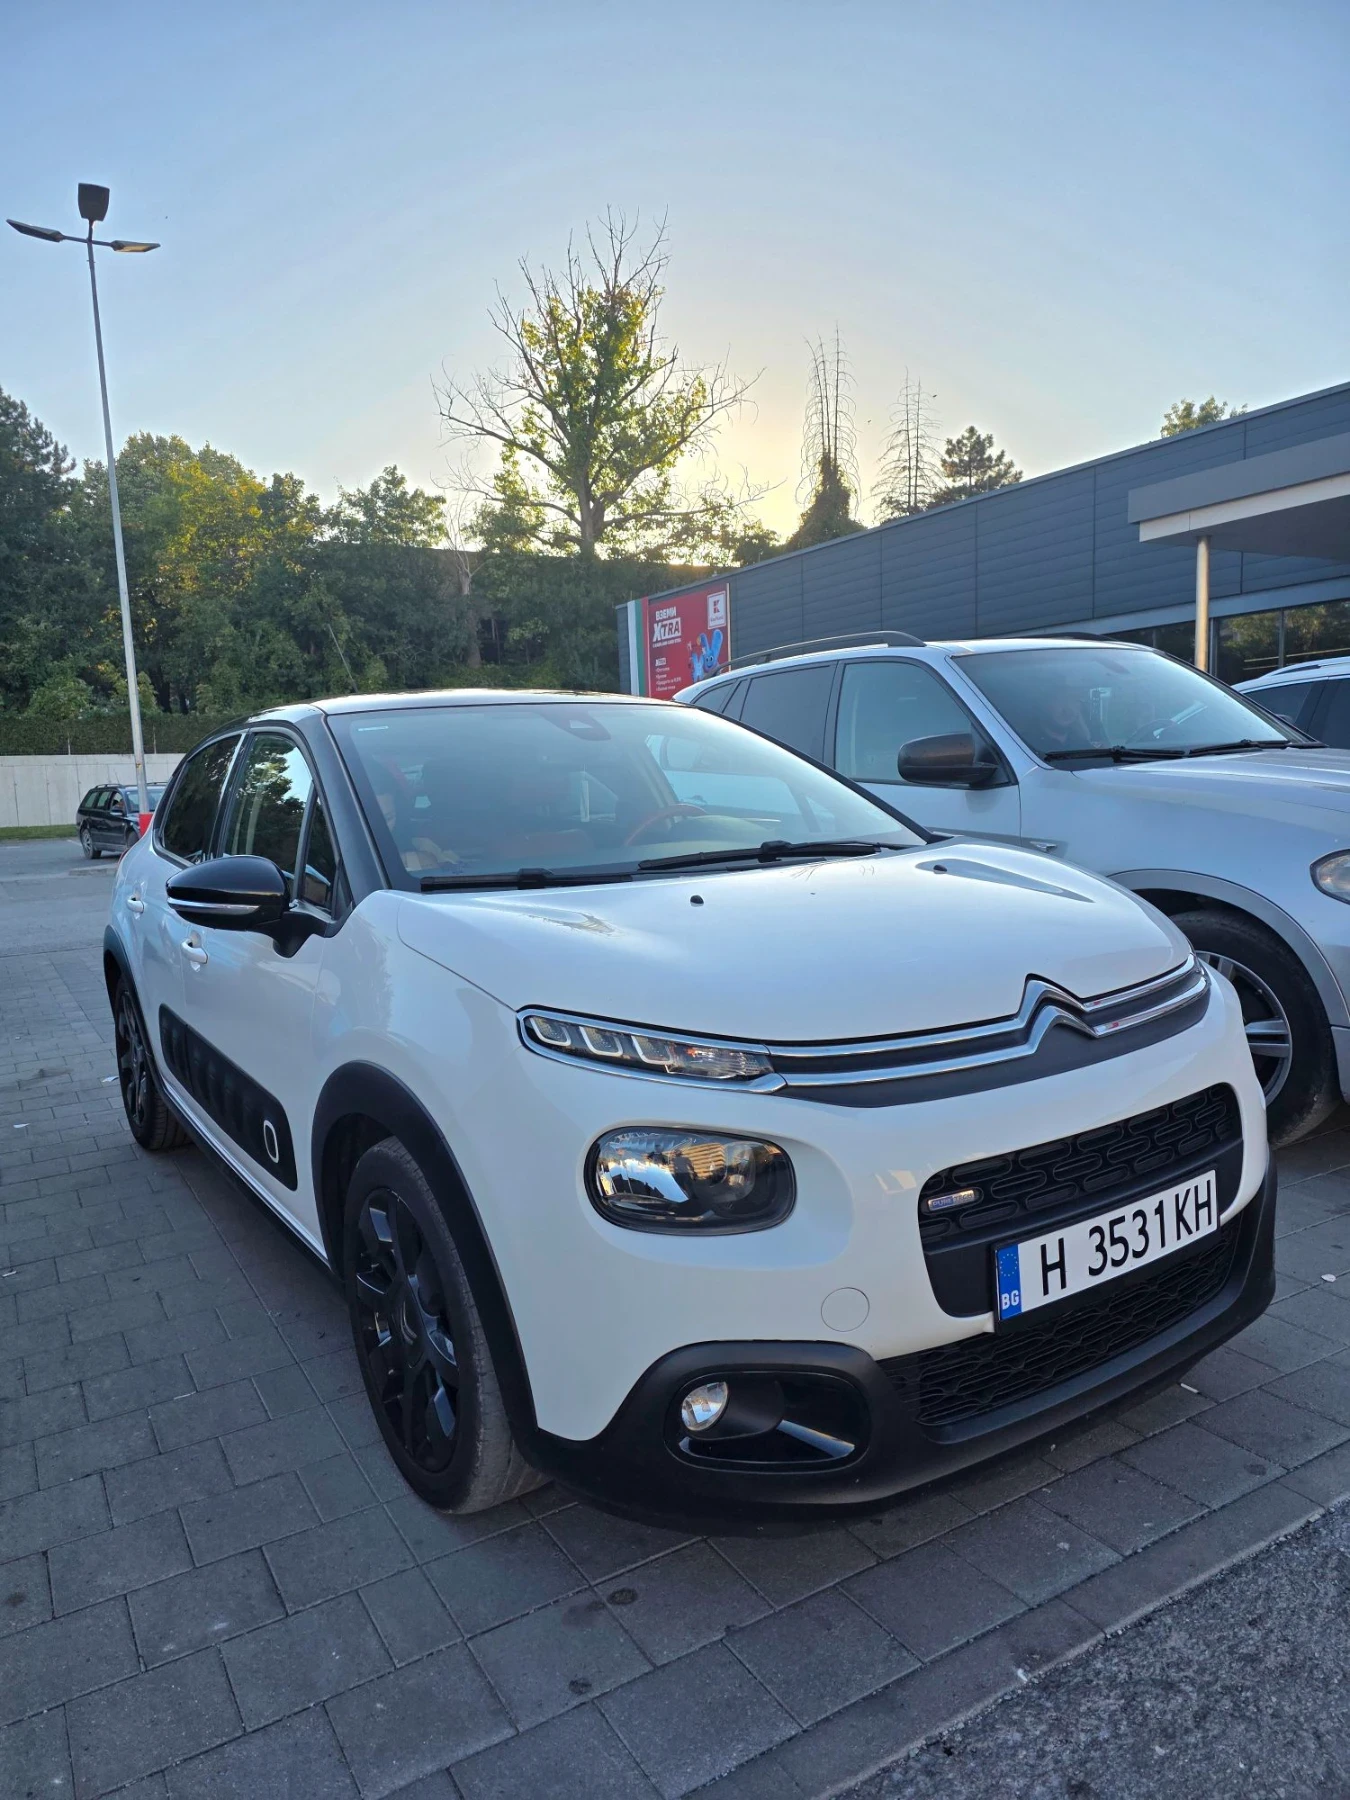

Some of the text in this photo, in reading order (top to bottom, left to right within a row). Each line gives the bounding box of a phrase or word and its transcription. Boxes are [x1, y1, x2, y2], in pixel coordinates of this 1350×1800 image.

[655, 606, 677, 621] ВЗЕМИ
[652, 618, 681, 642] XTRA
[1040, 1237, 1067, 1296] H
[1001, 1289, 1020, 1310] BG
